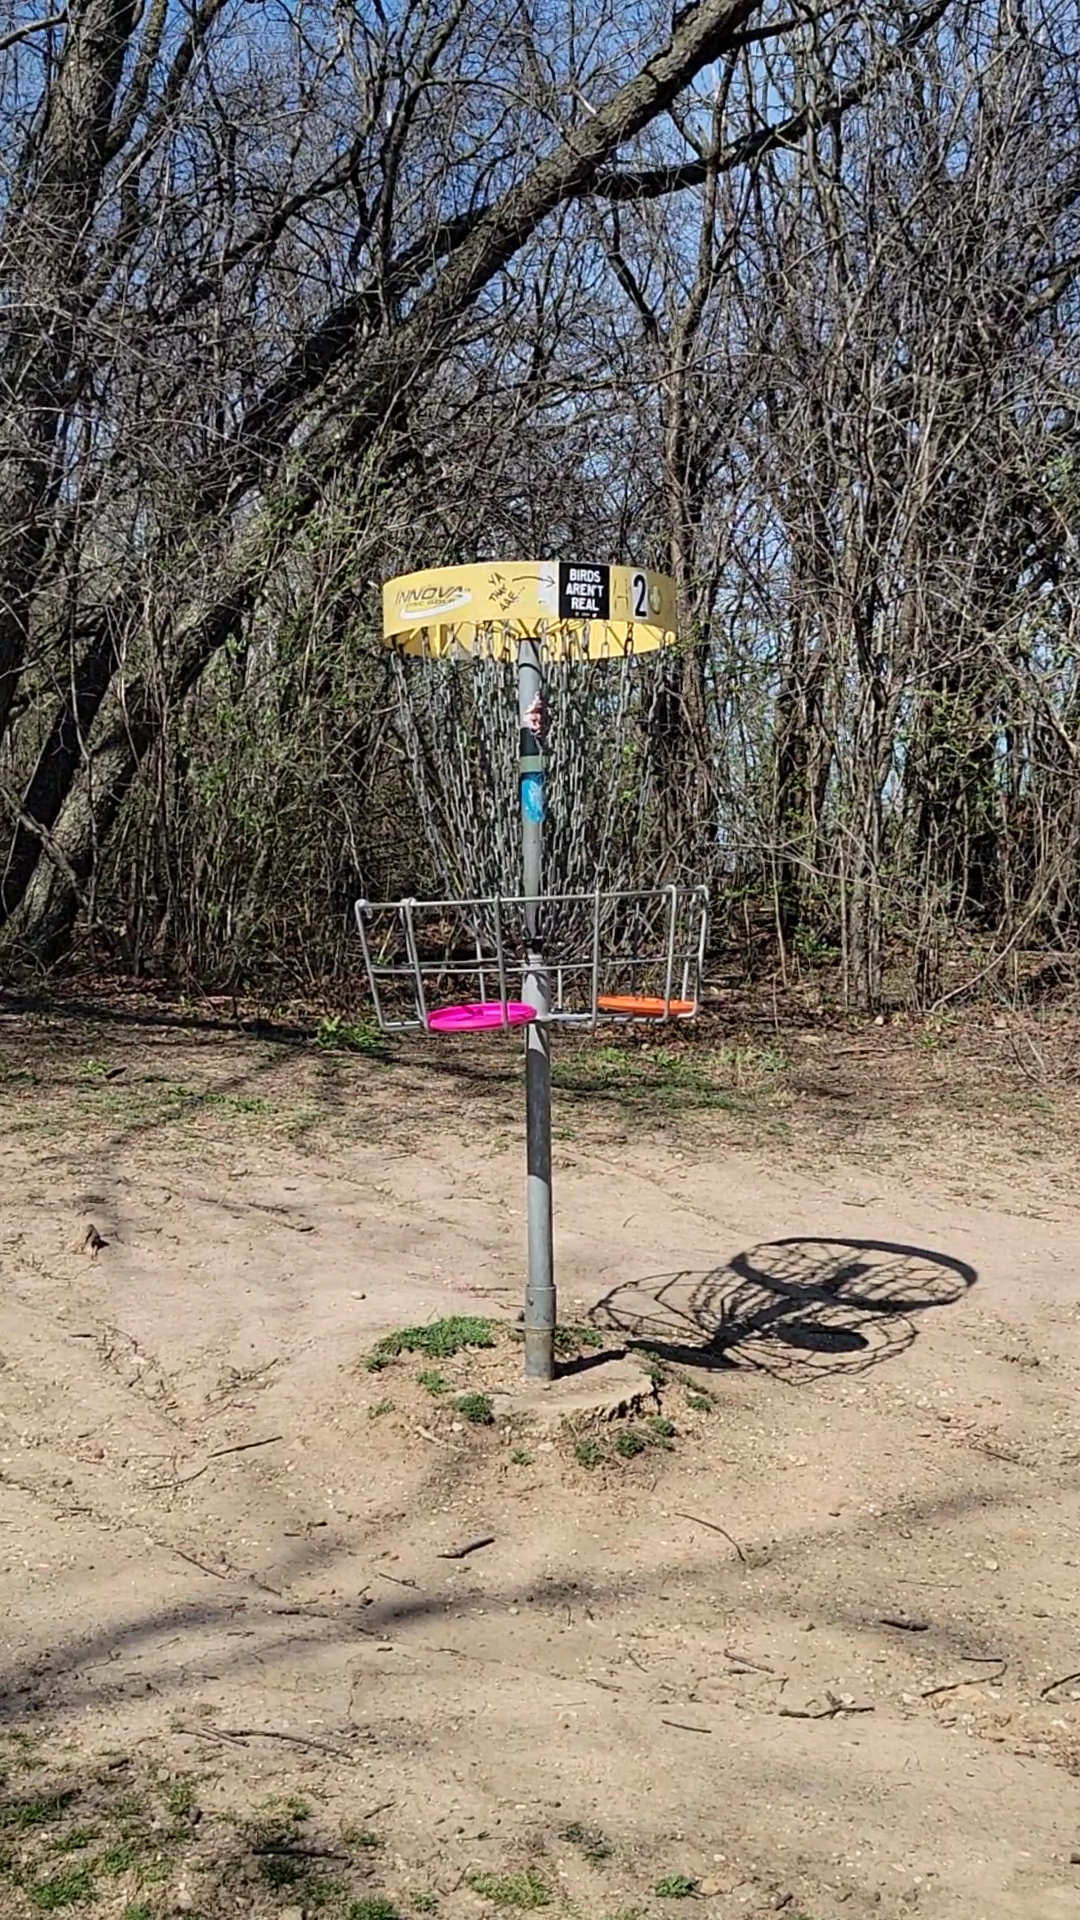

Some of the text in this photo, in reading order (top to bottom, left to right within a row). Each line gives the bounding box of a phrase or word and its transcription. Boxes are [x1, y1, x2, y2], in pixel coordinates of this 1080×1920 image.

[569, 568, 601, 583] BIRDS
[395, 585, 464, 605] INNOVA
[565, 582, 604, 597] AREN'T
[633, 574, 647, 617] 2
[571, 596, 600, 611] REAL
